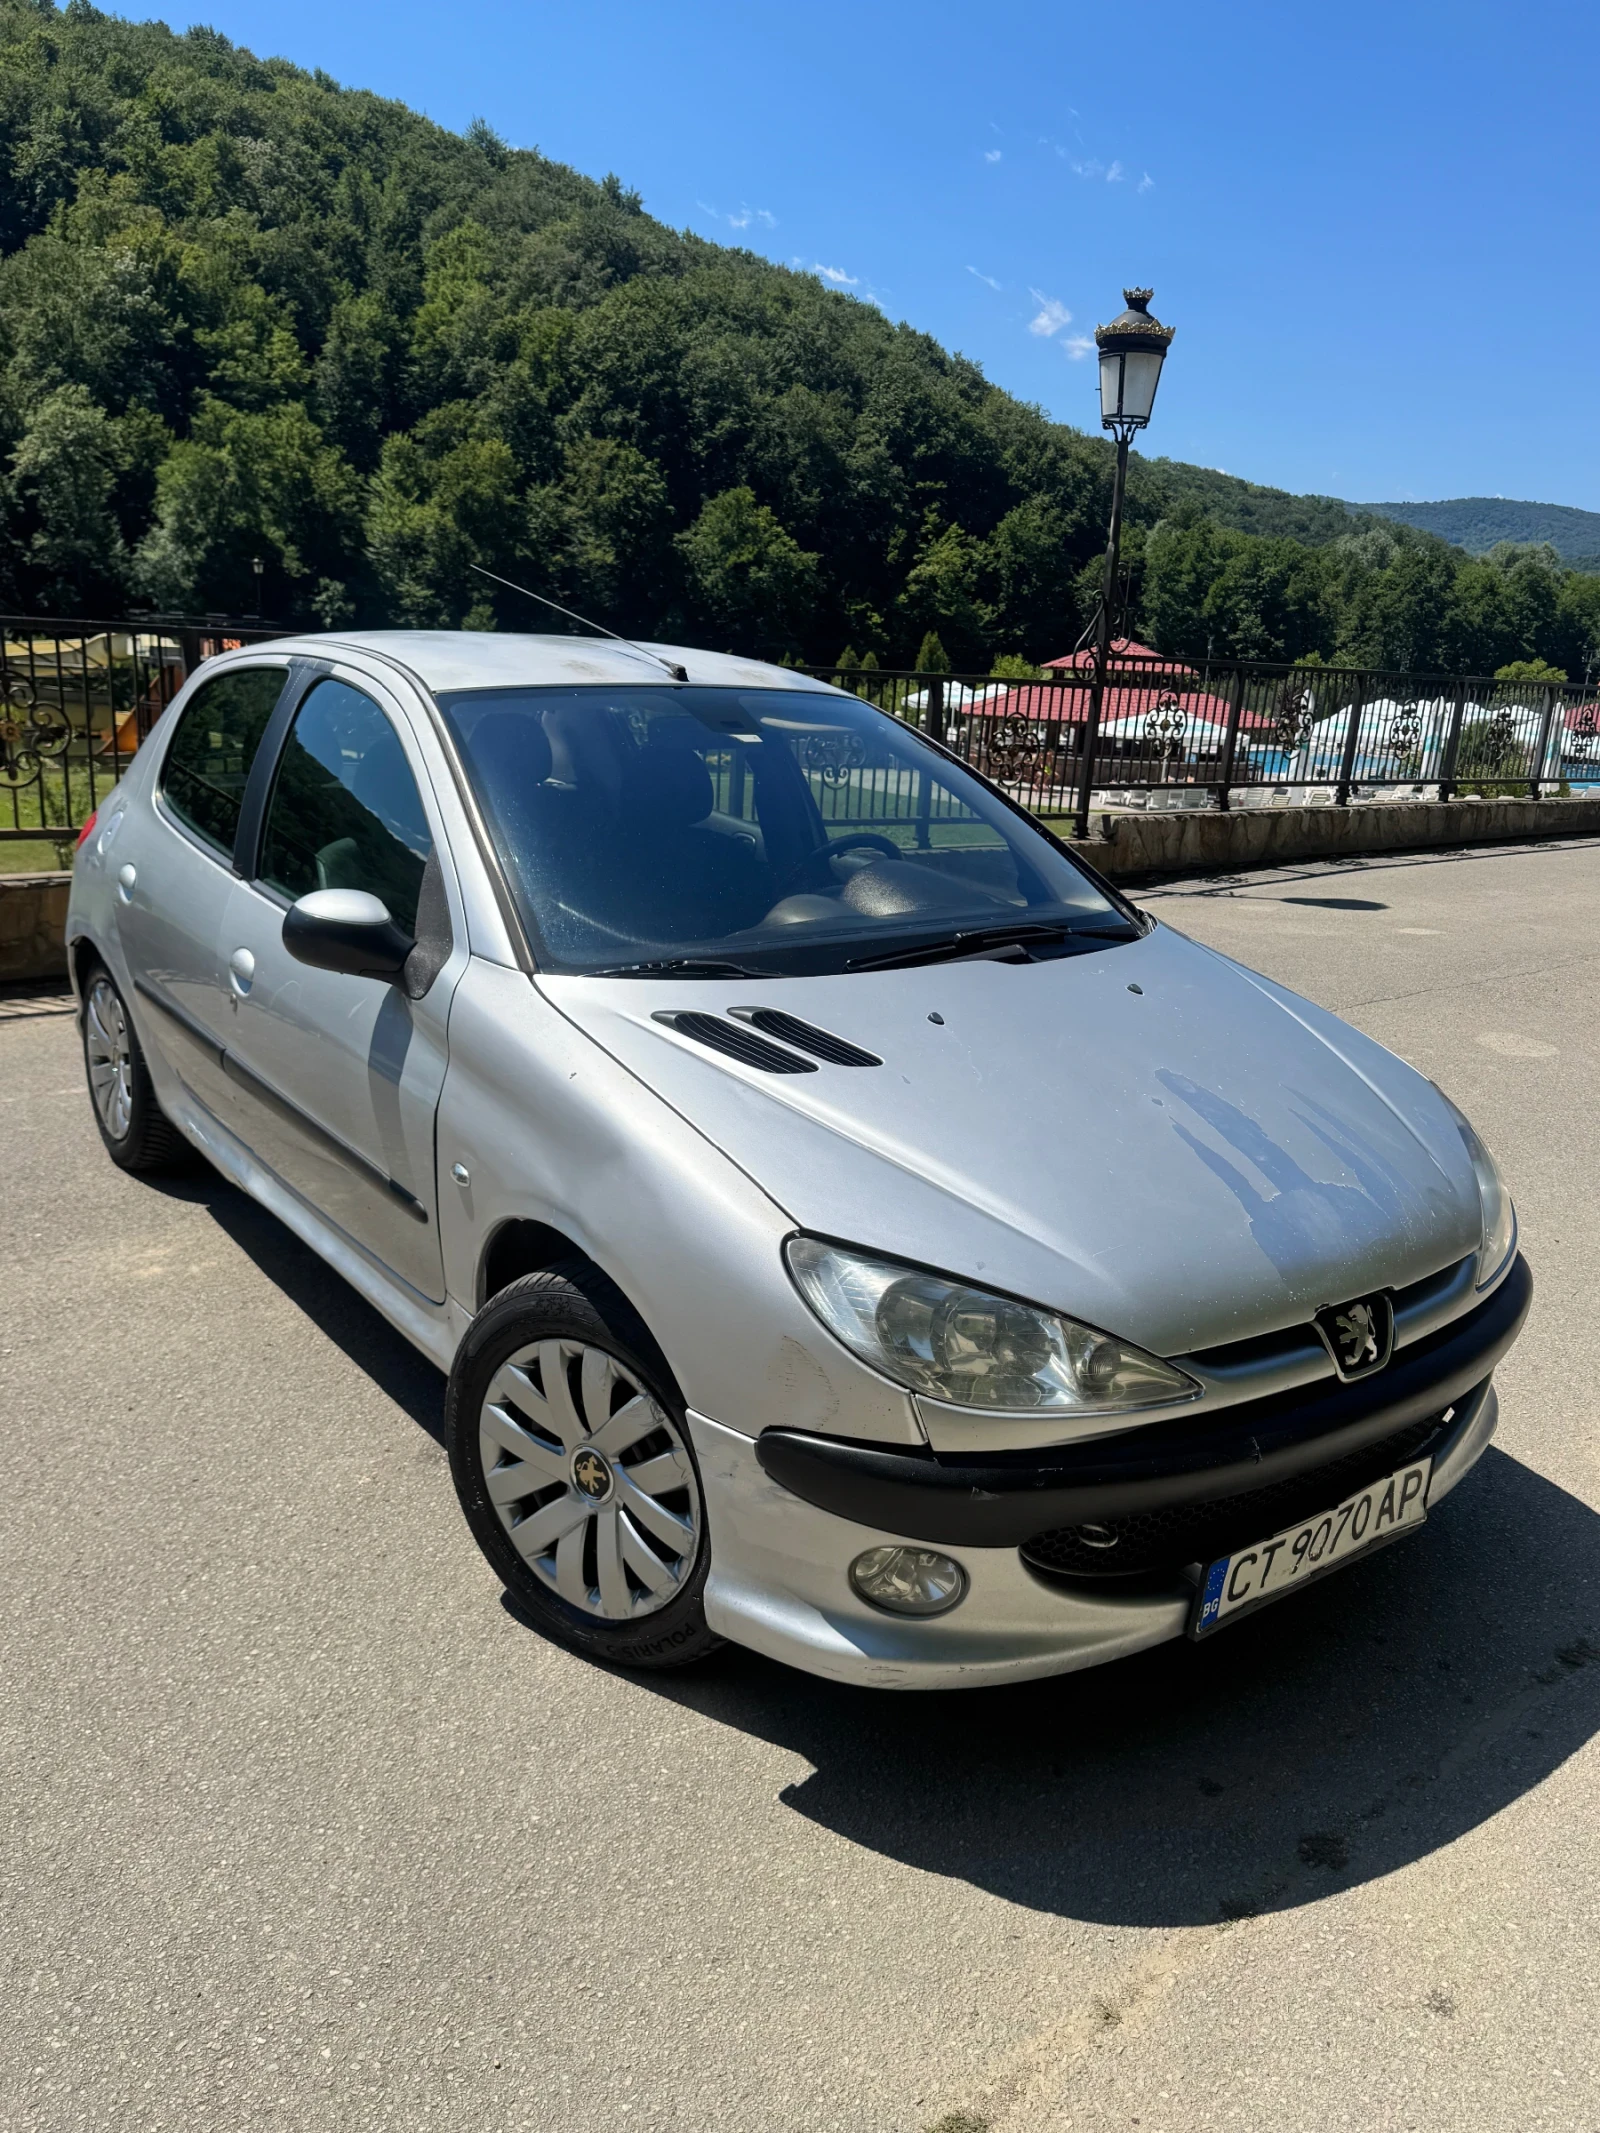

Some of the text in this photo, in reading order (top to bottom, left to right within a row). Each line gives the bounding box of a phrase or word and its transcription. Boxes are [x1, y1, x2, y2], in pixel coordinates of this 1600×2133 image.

[1227, 1468, 1423, 1602] CT 9070 AP
[1203, 1597, 1219, 1617] BG
[622, 1622, 696, 1657] POLARIS
